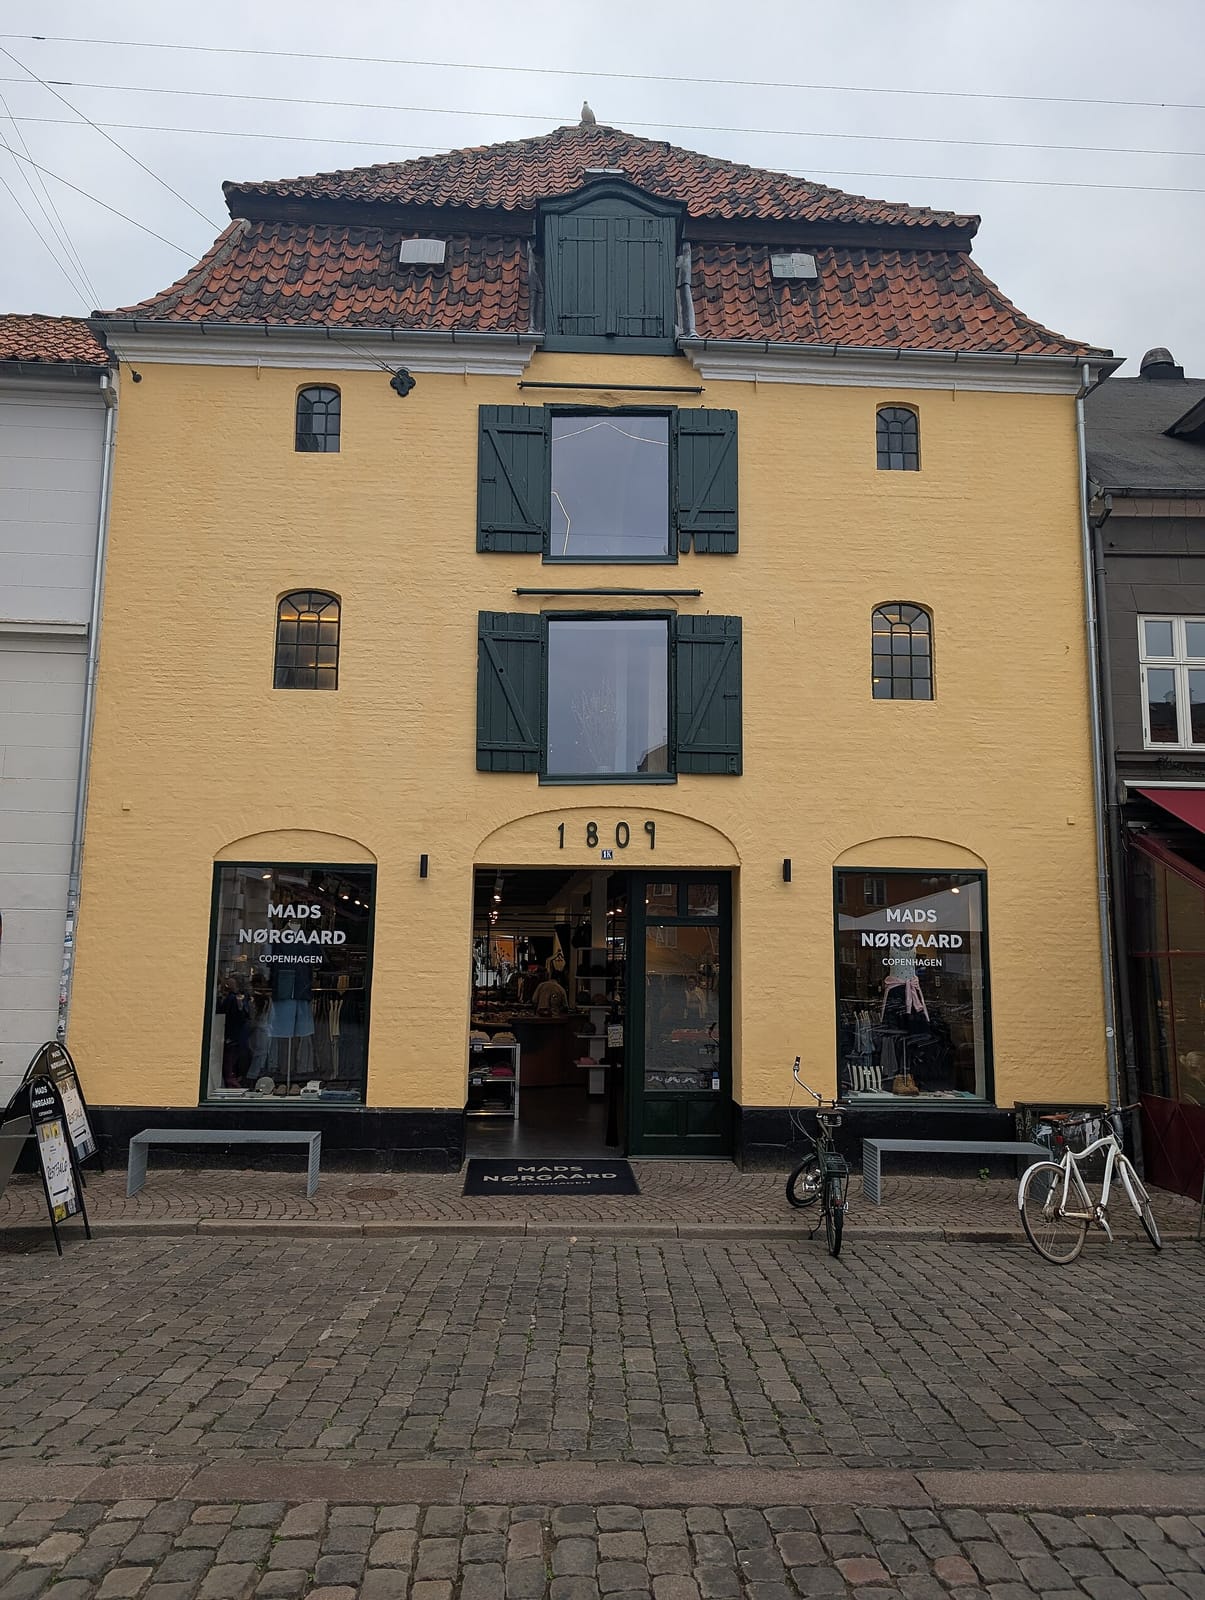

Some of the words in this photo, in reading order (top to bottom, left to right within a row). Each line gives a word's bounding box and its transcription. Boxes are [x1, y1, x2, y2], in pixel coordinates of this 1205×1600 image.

[557, 821, 656, 850] 1809
[267, 904, 322, 919] MADS
[886, 908, 937, 923] MADS
[239, 928, 346, 945] NØRGAARD
[861, 932, 963, 948] NØRGAARD
[259, 954, 323, 964] COPENHAGEN
[882, 958, 943, 967] COPENHAGEN
[483, 1173, 617, 1182] NØRGAARD
